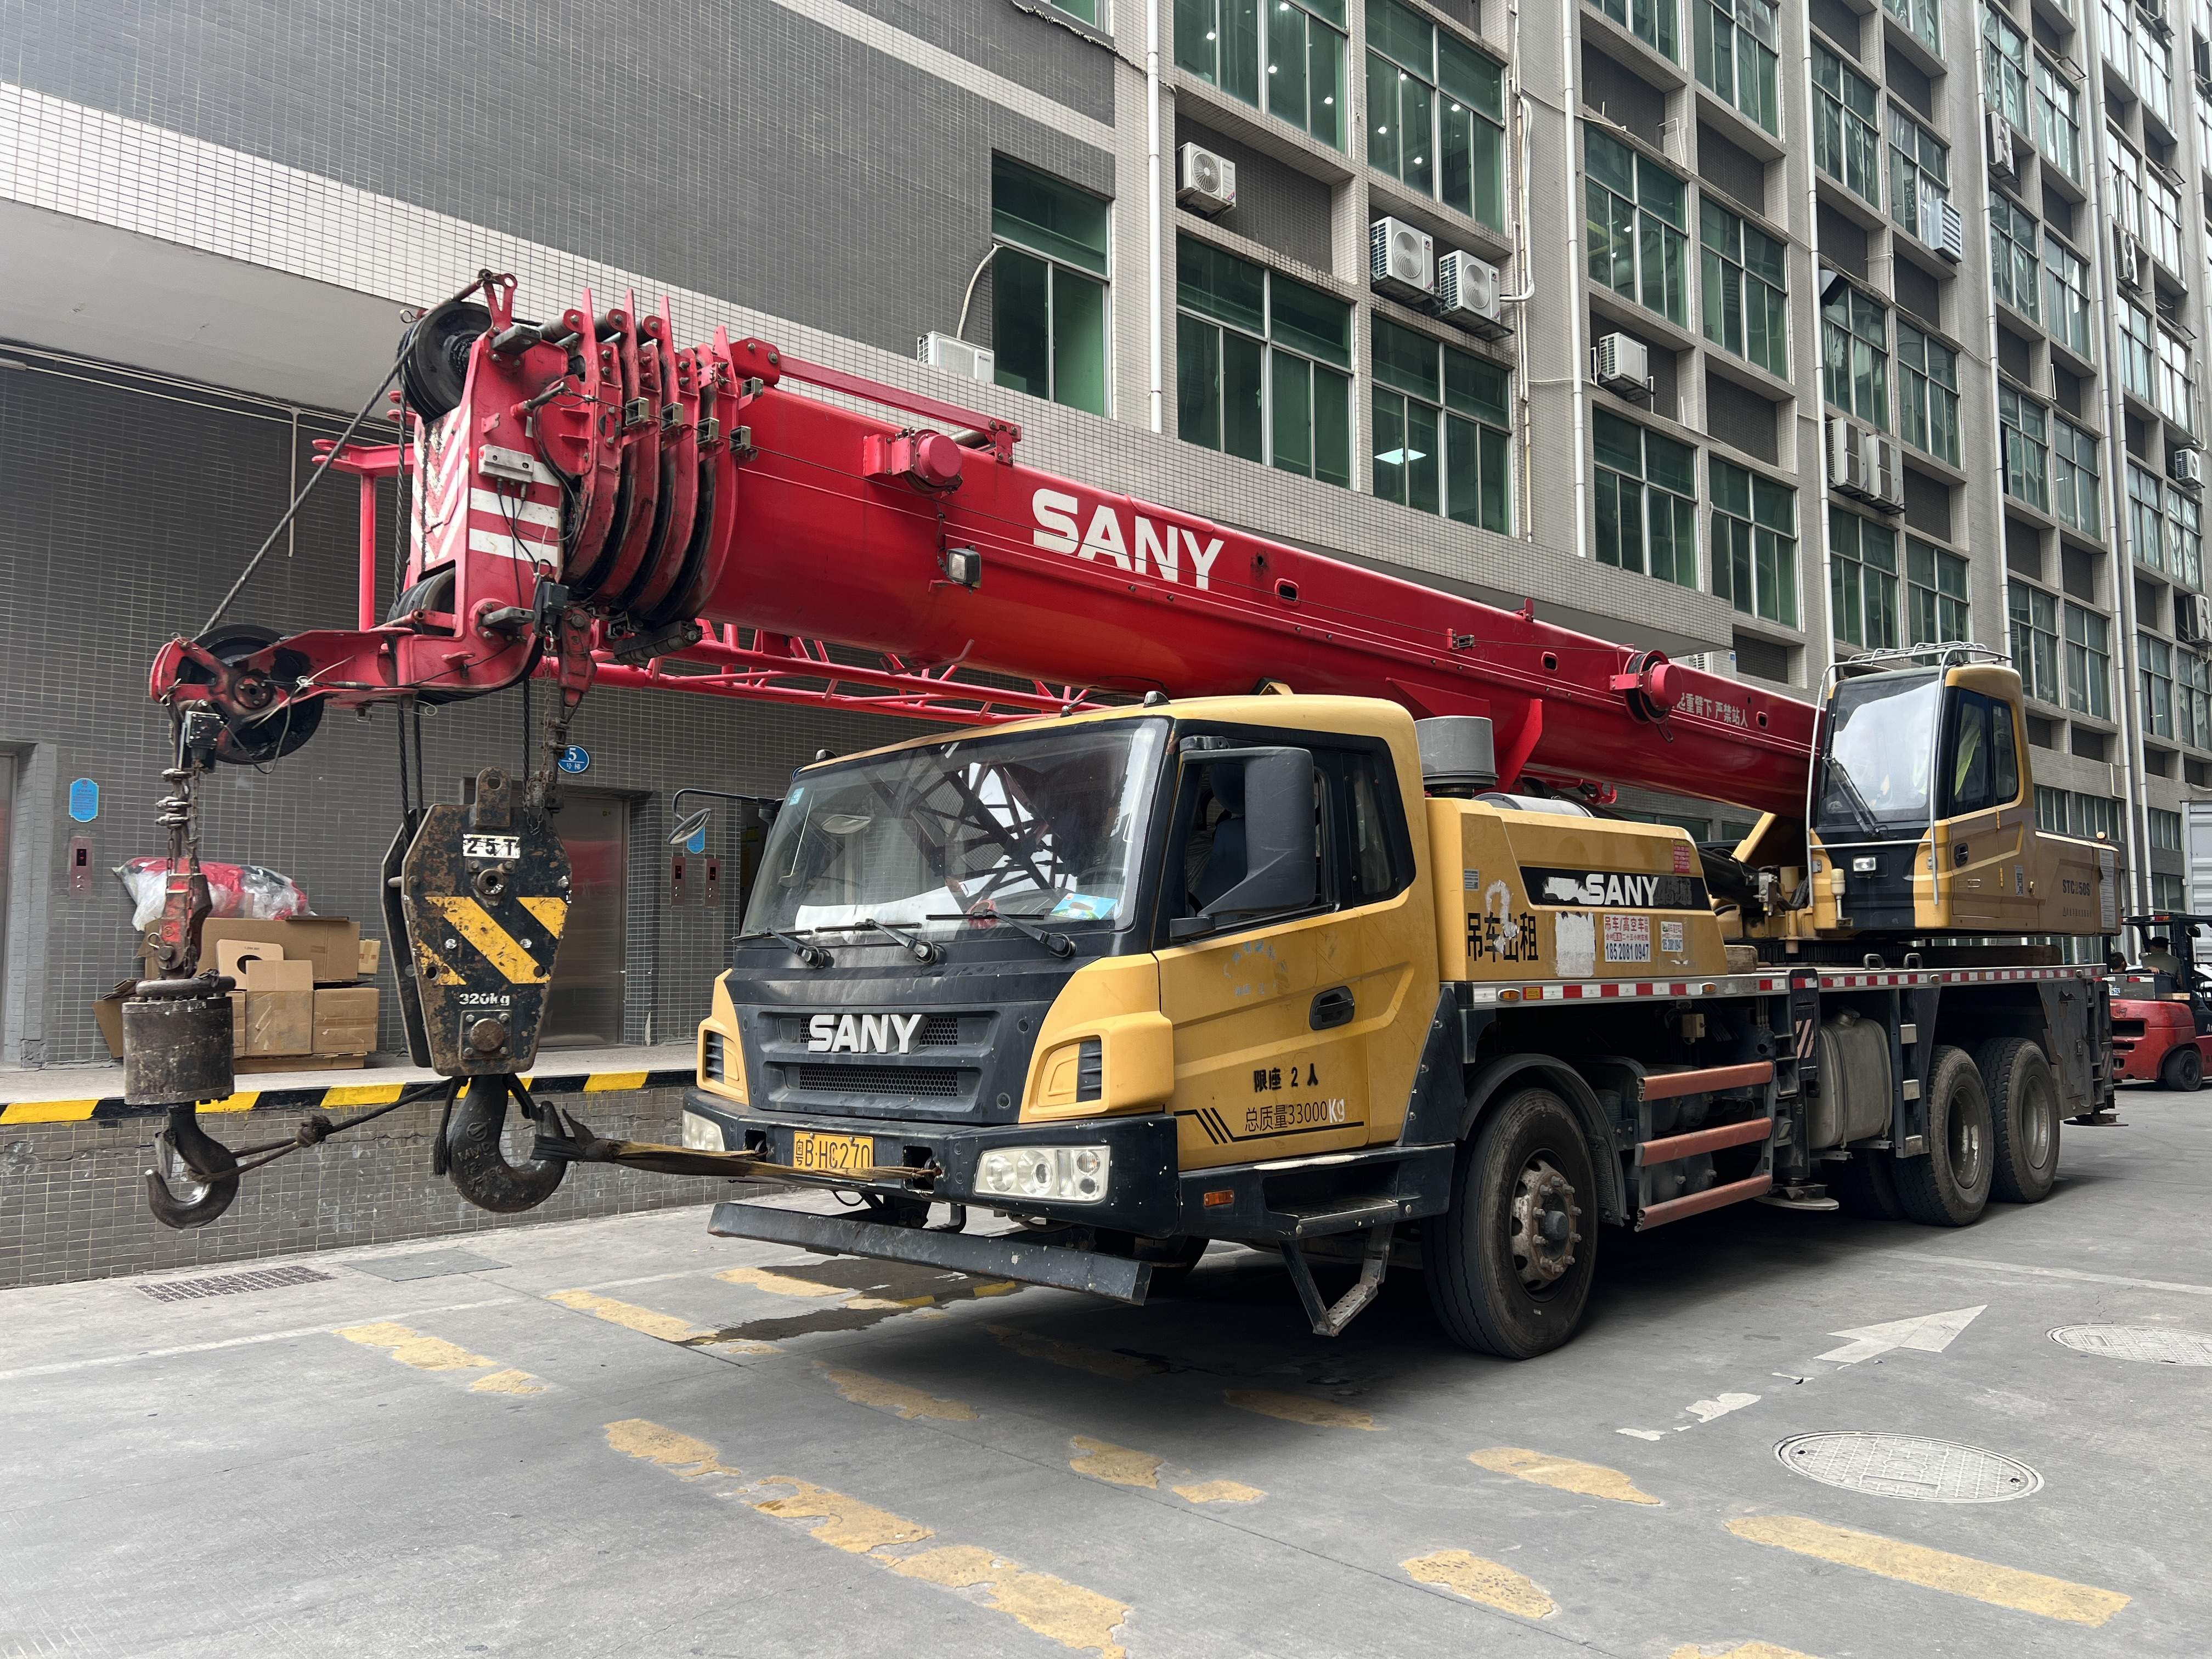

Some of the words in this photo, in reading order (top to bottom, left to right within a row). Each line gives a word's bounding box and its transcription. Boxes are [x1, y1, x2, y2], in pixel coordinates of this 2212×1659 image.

[1032, 488, 1224, 590] SANY
[1714, 701, 1748, 728] 严禁站人
[568, 747, 577, 761] 5
[467, 837, 516, 856] 25T
[1585, 874, 1660, 906] SANY
[1606, 943, 1617, 960] 185
[1618, 943, 1633, 960] 2081
[1635, 943, 1649, 960] 0947
[459, 992, 510, 1006] 320kg
[808, 1014, 922, 1053] SANY
[1254, 1068, 1282, 1093] 限座
[1291, 1066, 1299, 1087] 2
[1307, 1063, 1319, 1086] 人
